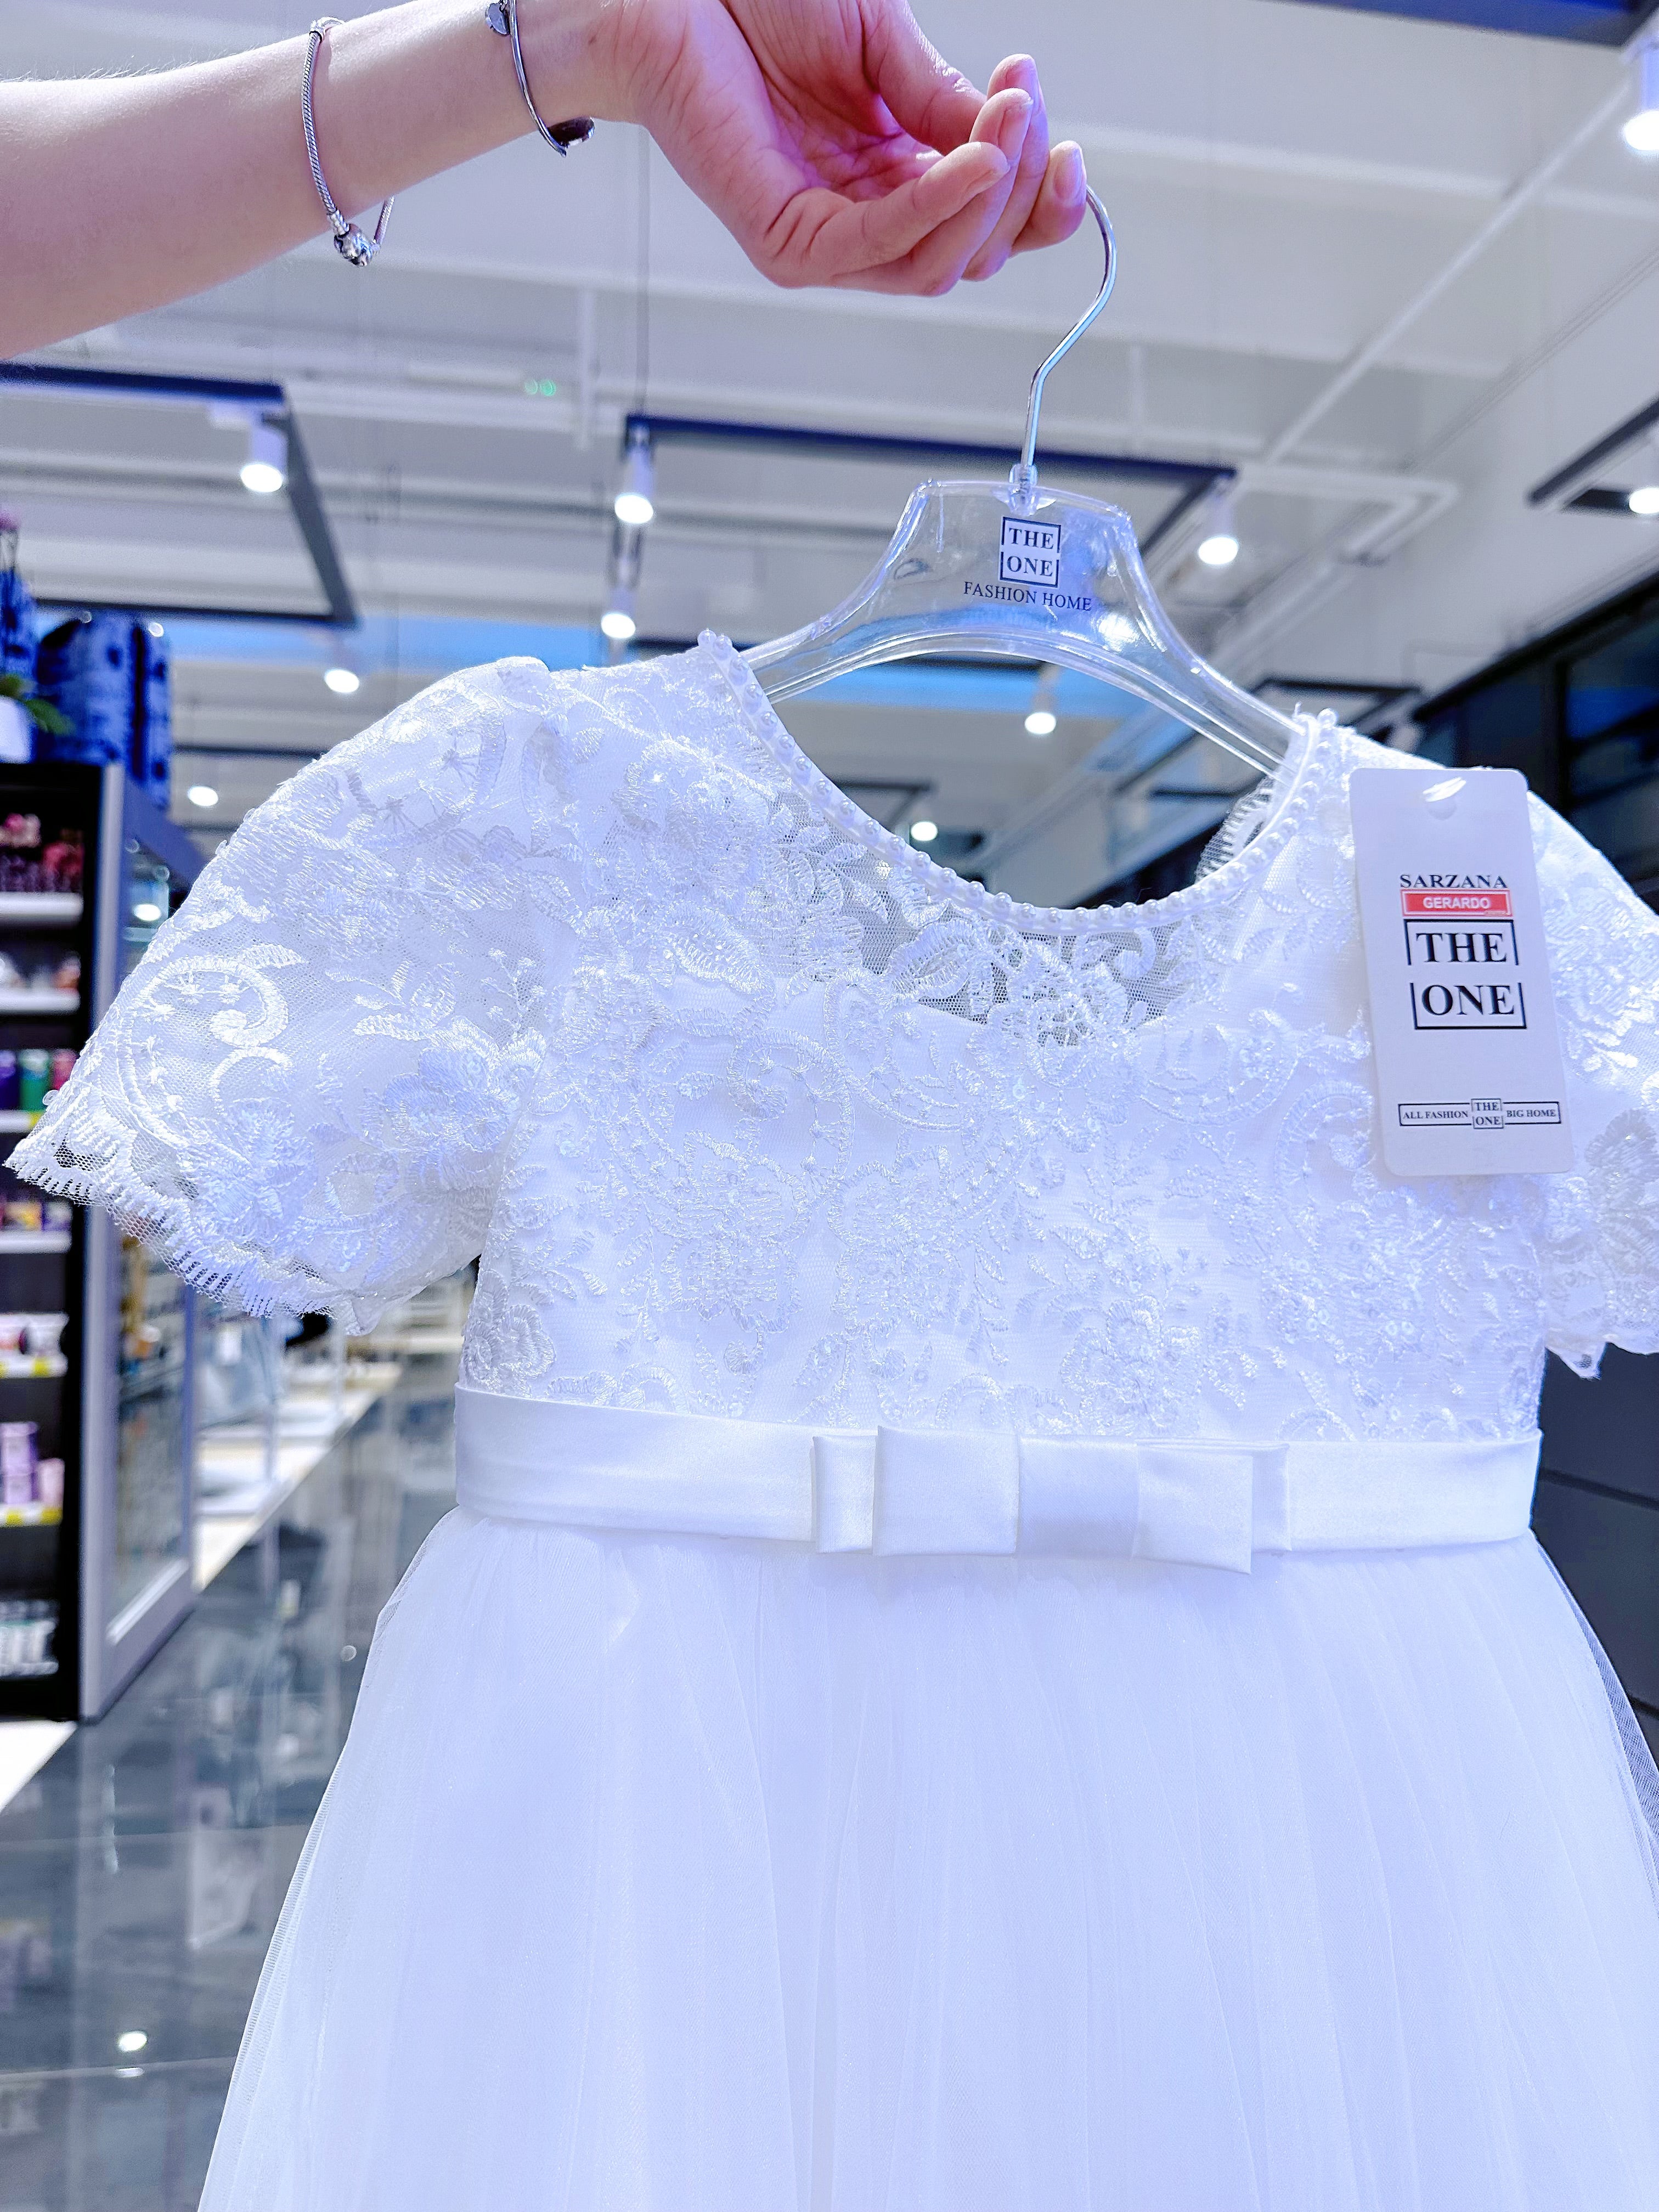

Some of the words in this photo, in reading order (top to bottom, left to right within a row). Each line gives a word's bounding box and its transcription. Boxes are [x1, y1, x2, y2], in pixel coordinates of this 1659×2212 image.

[1008, 527, 1054, 550] THE
[1007, 556, 1053, 577] ONE
[963, 581, 1037, 604] FASHION
[1043, 592, 1092, 611] HOME
[1400, 874, 1508, 889] SARZANA
[1423, 897, 1491, 909] GERARDO
[1415, 933, 1507, 963] THE
[1421, 984, 1515, 1016] ONE
[1475, 1102, 1499, 1111] THE
[1526, 1109, 1557, 1117] HOME
[1403, 1111, 1424, 1119] ALL
[1425, 1110, 1469, 1119] FASHION
[1475, 1116, 1501, 1126] ONE
